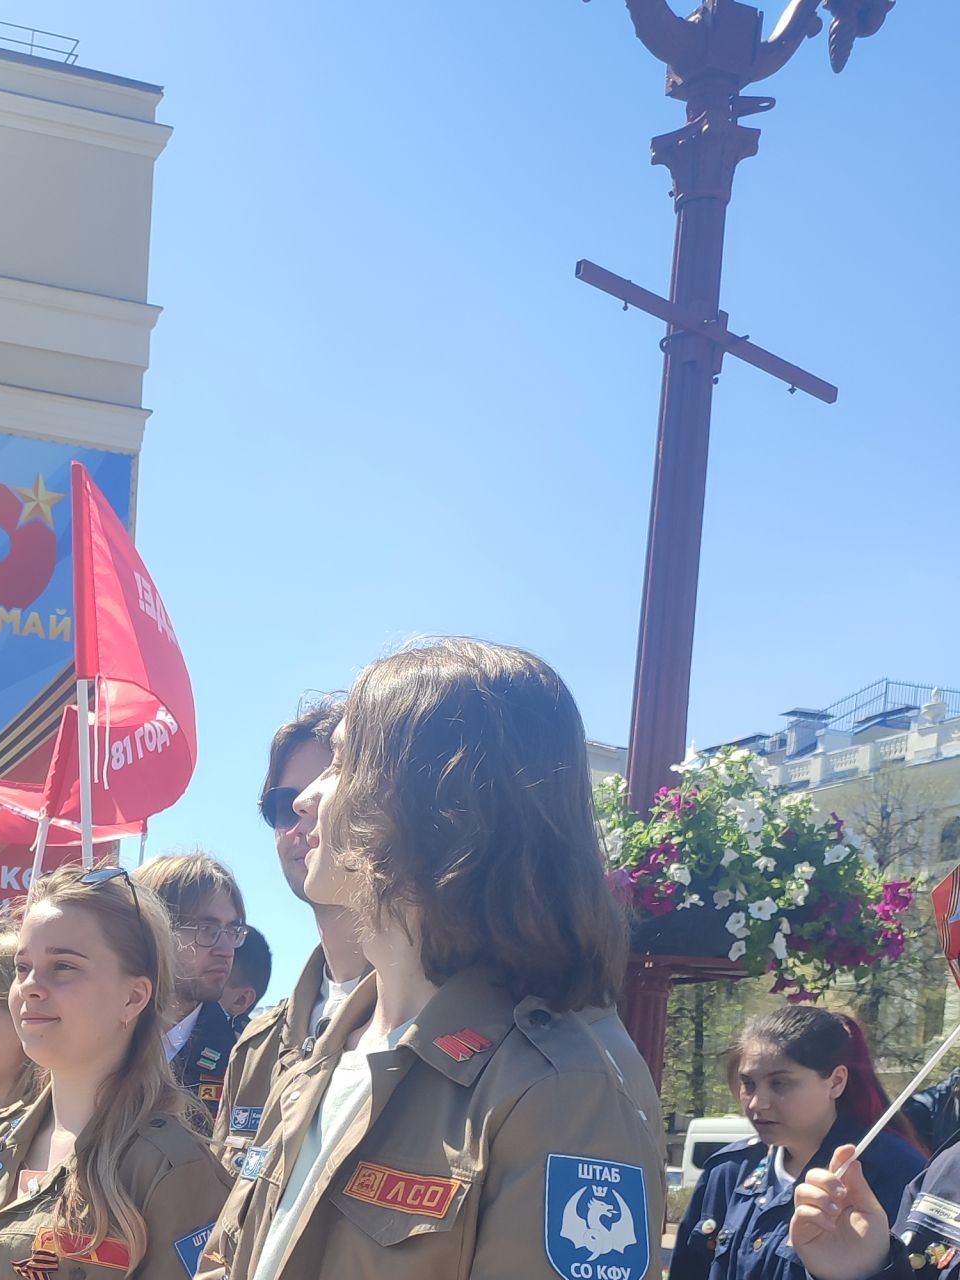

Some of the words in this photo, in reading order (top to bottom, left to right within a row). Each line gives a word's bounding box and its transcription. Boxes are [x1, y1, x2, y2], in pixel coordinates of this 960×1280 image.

[111, 735, 133, 771] 81
[134, 720, 170, 760] ГОД
[577, 1163, 622, 1184] ШТАБ
[386, 1180, 444, 1208] ЛСО
[192, 1230, 211, 1247] ШТ
[570, 1262, 593, 1280] СО
